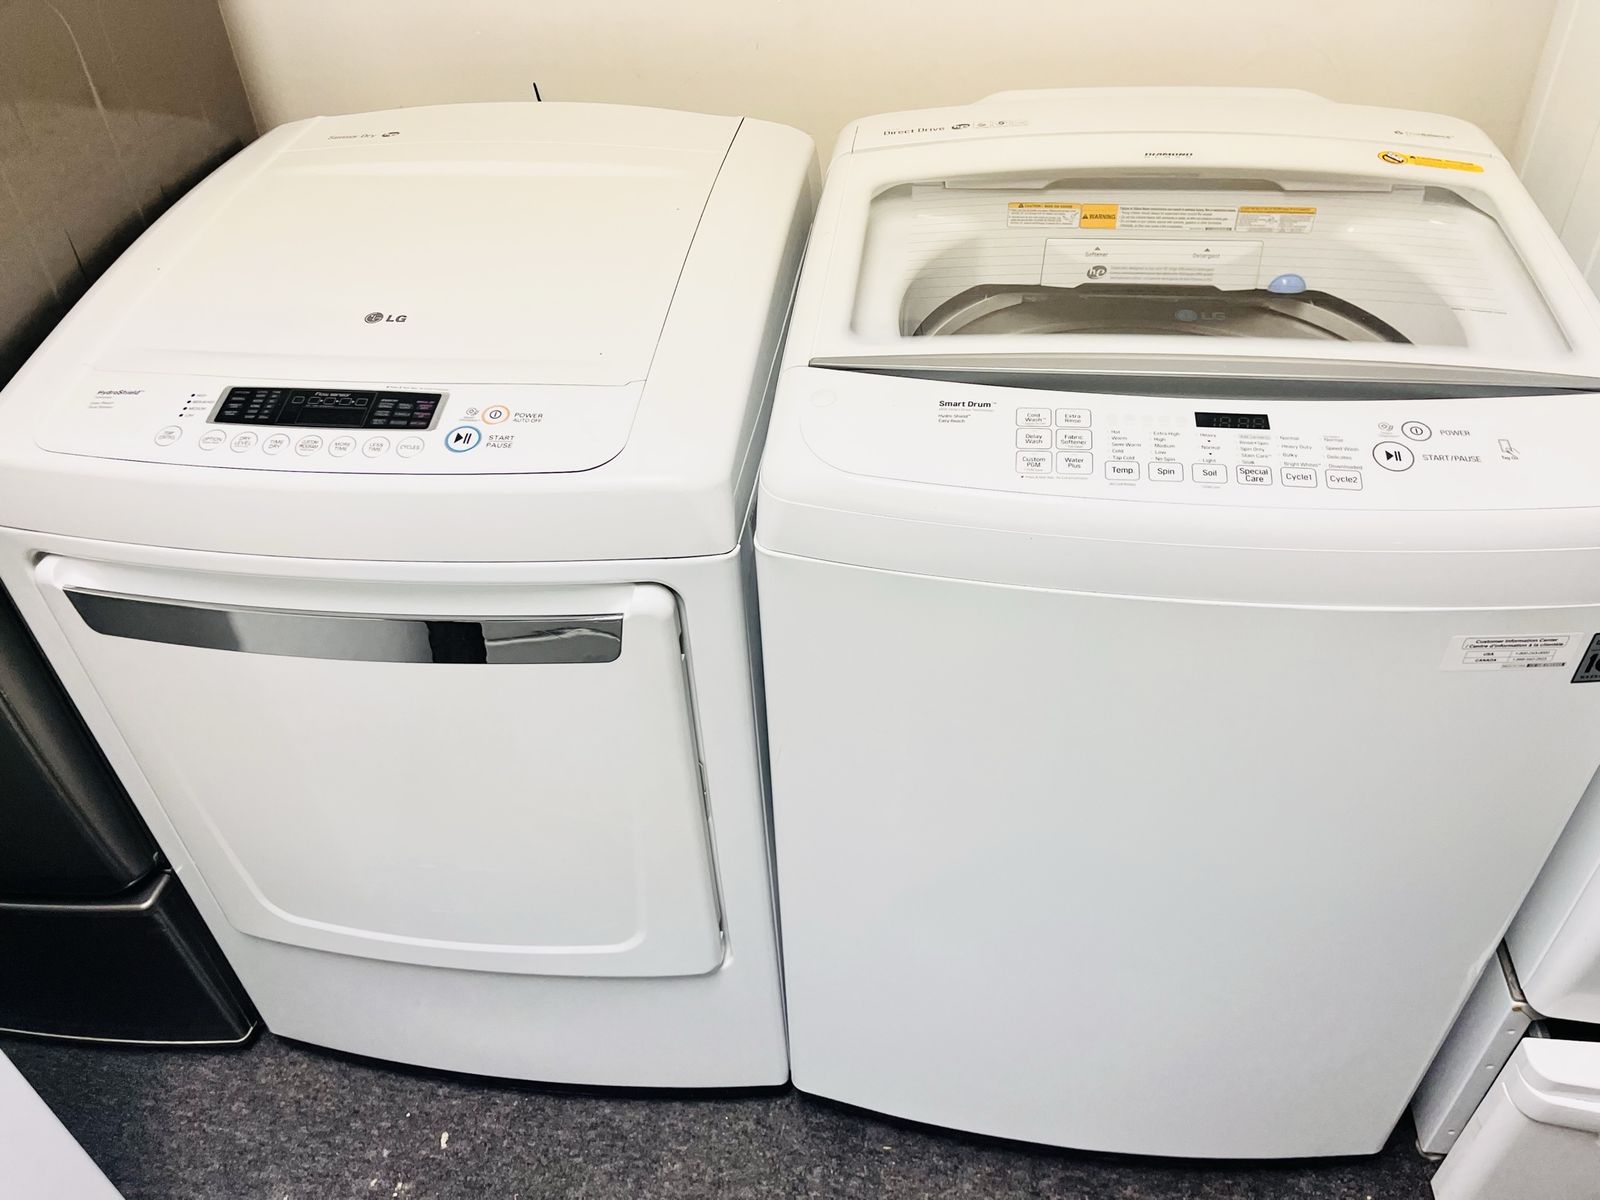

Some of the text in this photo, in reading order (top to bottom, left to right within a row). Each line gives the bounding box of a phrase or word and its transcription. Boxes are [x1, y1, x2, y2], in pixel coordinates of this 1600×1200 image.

[1192, 252, 1221, 260] Detergent
[385, 314, 408, 322] LG
[1201, 311, 1226, 320] LG
[1439, 429, 1471, 437] POWER
[1421, 453, 1482, 463] START/PAUSE
[1111, 465, 1134, 475] Temp
[1157, 467, 1175, 476] Spin
[1202, 469, 1218, 477] Soil
[1239, 466, 1269, 476] Special
[1245, 475, 1264, 483] Care
[1285, 472, 1313, 482] Cycle1
[1329, 474, 1359, 484] Cycle2
